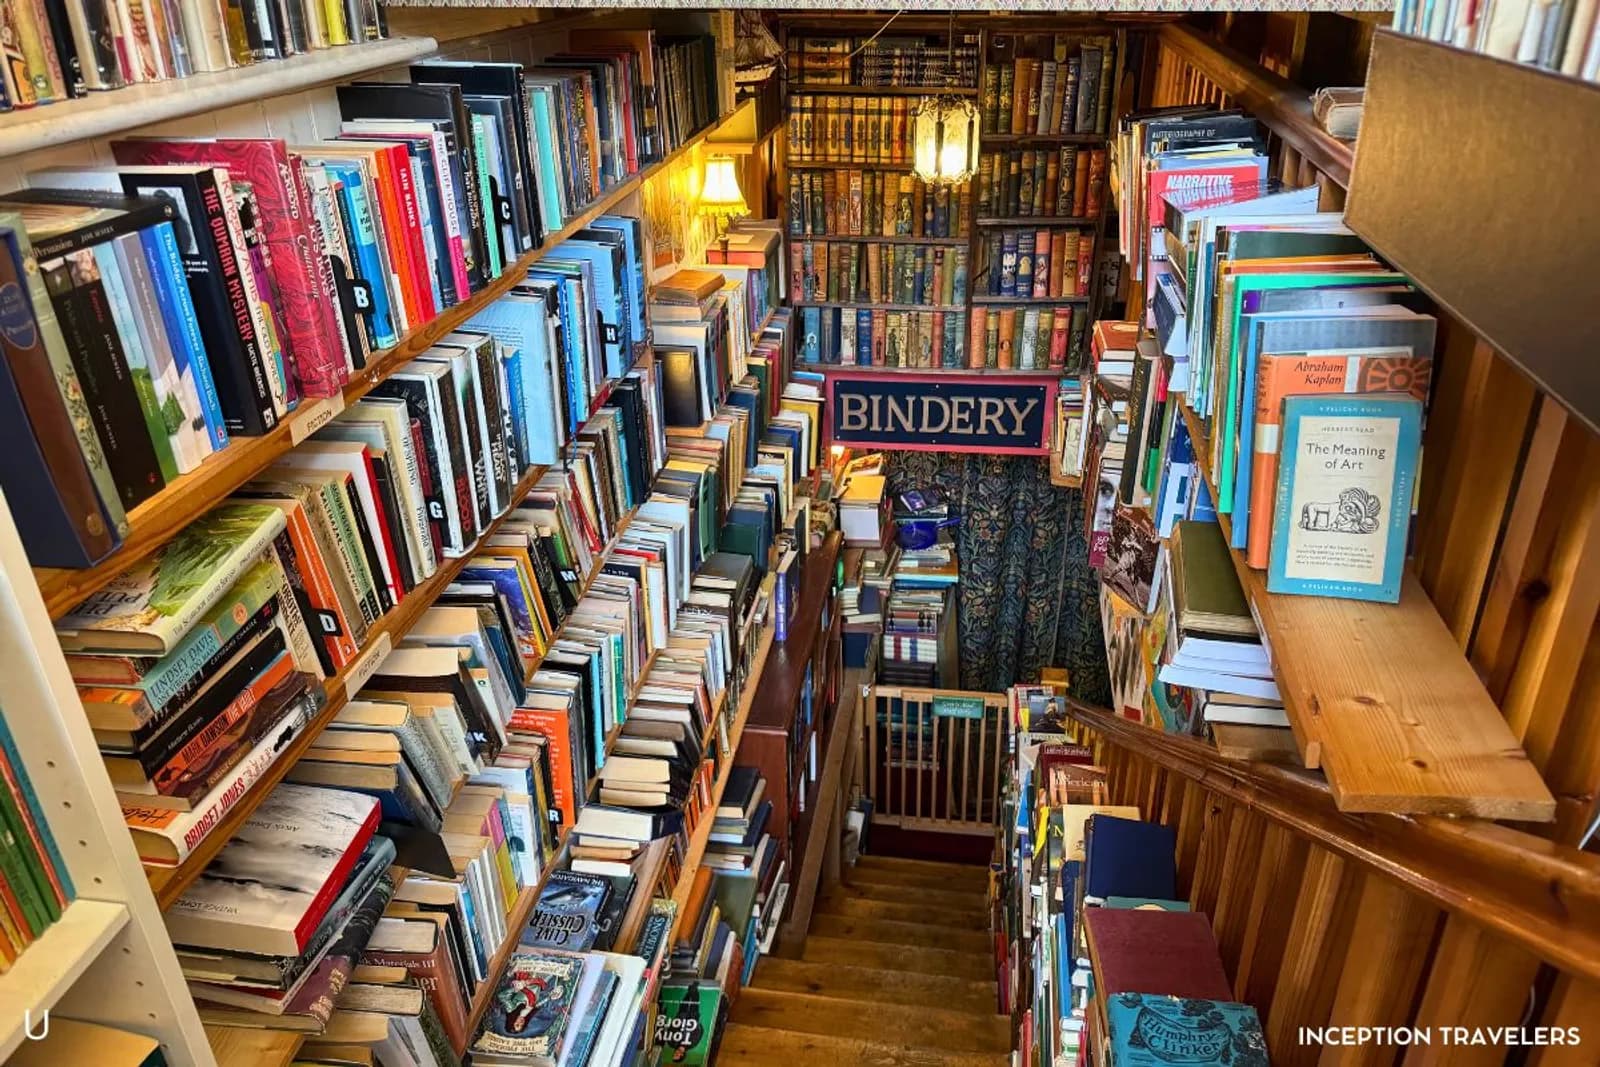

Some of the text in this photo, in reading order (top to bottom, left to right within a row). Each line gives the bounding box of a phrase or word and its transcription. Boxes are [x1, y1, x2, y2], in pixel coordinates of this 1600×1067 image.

[1152, 129, 1206, 139] AUTOBIOGRAPHY
[278, 162, 300, 220] ACKROYD
[1166, 174, 1234, 190] NARRATIVE
[399, 168, 417, 229] IAIN BANKS
[501, 202, 510, 219] C
[164, 233, 173, 248] The
[169, 250, 182, 285] Bridge
[203, 186, 254, 344] THE QUMRAN MYSTERY
[354, 286, 370, 309] B
[1294, 361, 1344, 374] Abraham
[1304, 374, 1342, 387] Kaplan
[840, 393, 1038, 437] BINDERY
[1306, 442, 1386, 460] The Meaning
[1324, 458, 1364, 470] of Art
[474, 457, 488, 511] WHITE
[428, 500, 444, 520] G
[455, 474, 472, 532] BLOOD
[560, 570, 577, 582] M
[318, 613, 336, 633] D
[150, 630, 216, 698] LINDSEY DAVIS
[182, 744, 200, 765] MARK
[201, 720, 230, 750] DAWSON
[472, 730, 488, 743] K
[184, 778, 246, 850] BRIDGET JONES
[550, 809, 560, 822] R
[530, 909, 586, 934] CUSSLER
[535, 929, 569, 946] CLIVE
[654, 1028, 692, 1046] Tony
[1142, 1015, 1217, 1046] Humphry
[1149, 1036, 1222, 1056] Clinker
